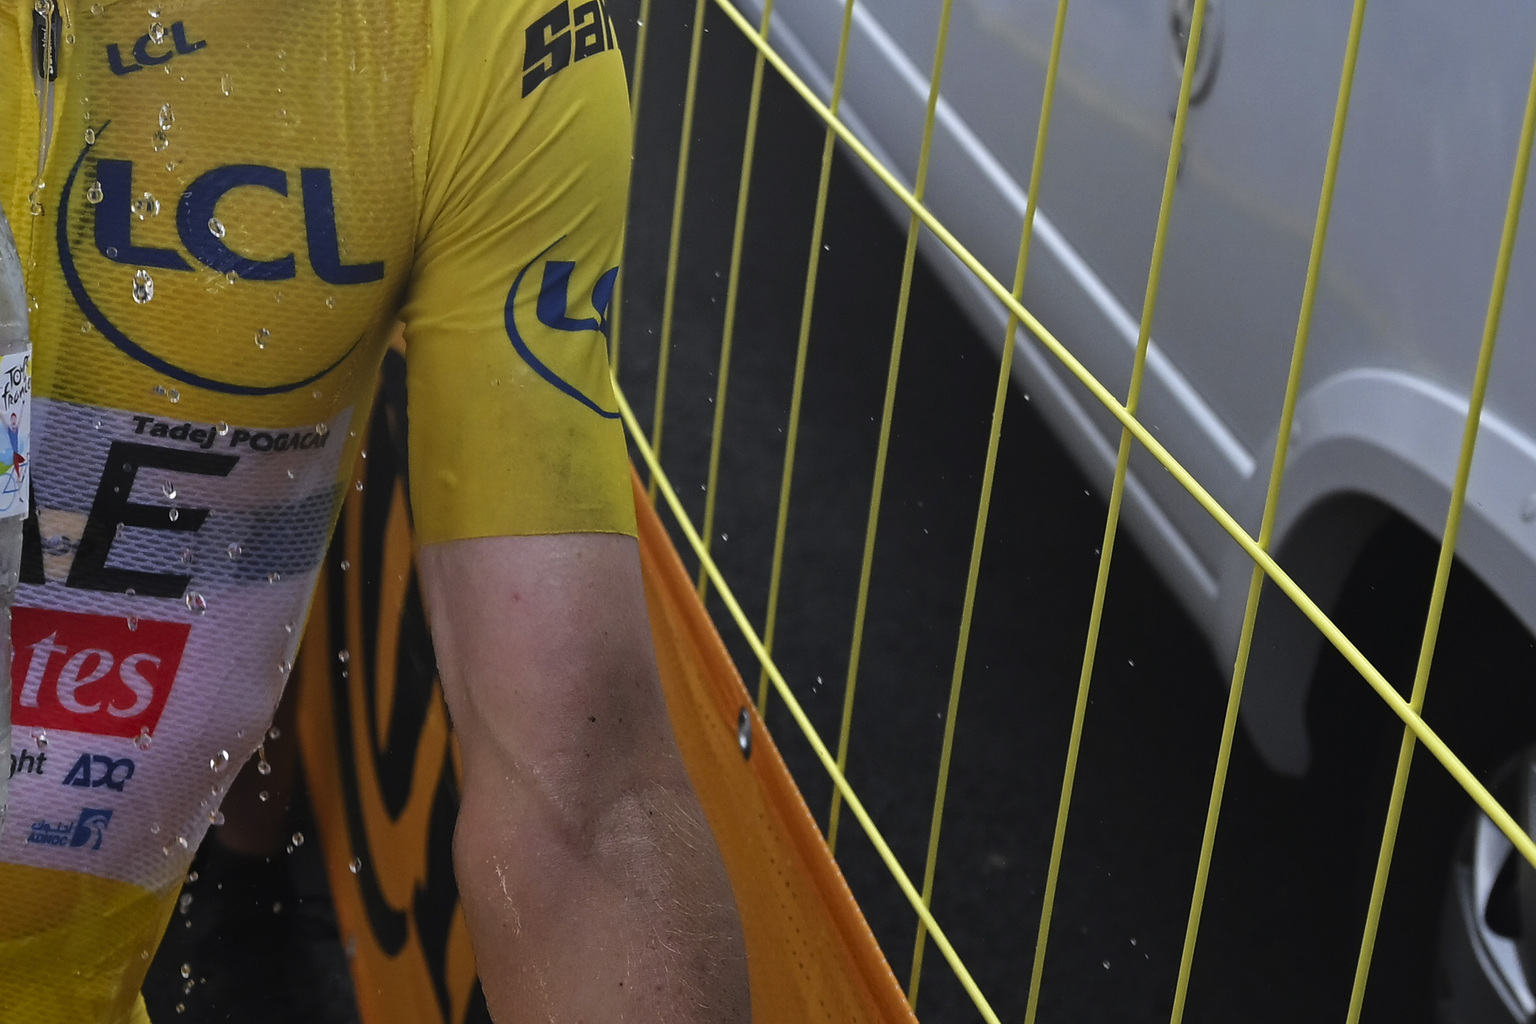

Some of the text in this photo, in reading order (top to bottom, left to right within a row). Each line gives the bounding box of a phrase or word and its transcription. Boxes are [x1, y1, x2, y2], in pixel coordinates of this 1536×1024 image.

[106, 21, 207, 76] LCL
[93, 159, 385, 285] LCL
[133, 415, 218, 450] Tadej
[19, 630, 162, 718] tes
